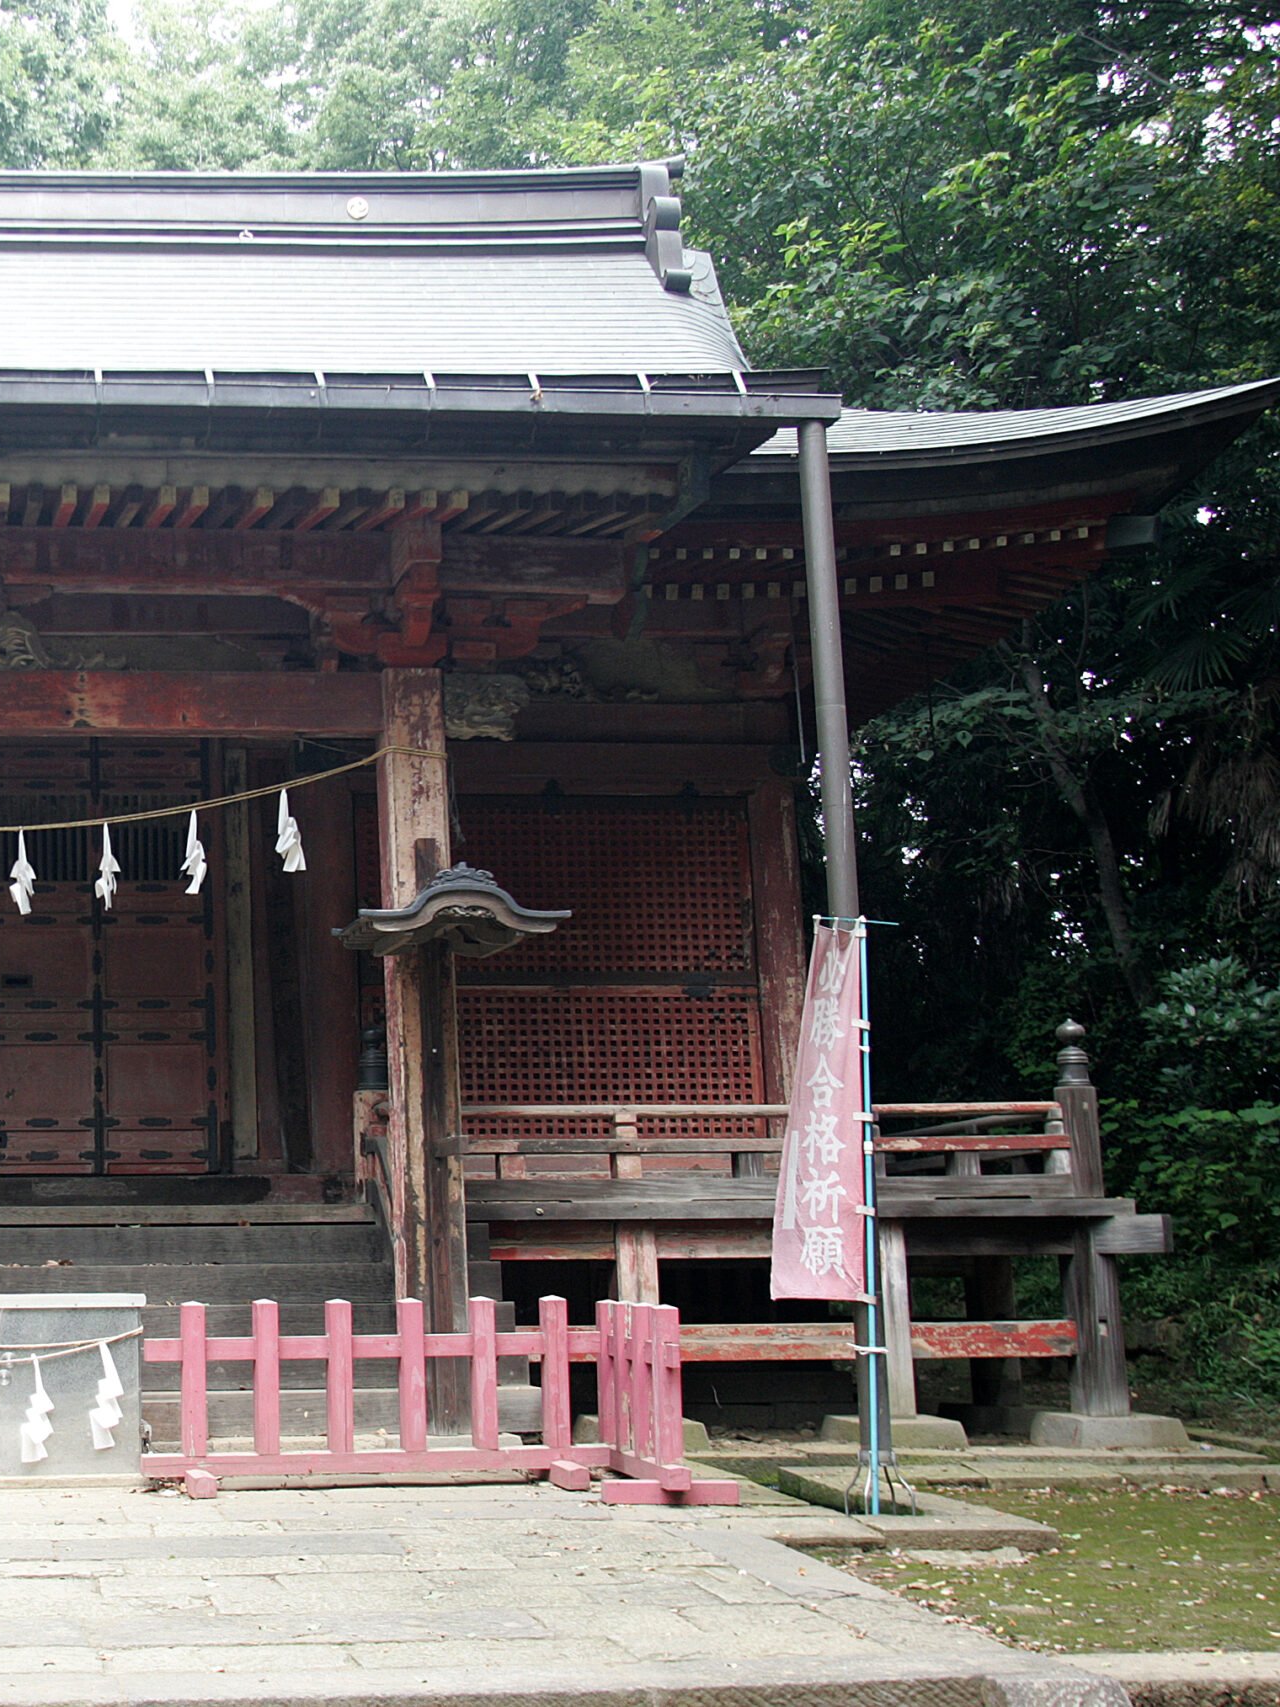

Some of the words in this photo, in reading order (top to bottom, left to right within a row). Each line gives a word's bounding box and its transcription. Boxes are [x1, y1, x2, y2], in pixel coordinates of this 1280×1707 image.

[800, 949, 847, 1280] 必勝合格祈願
